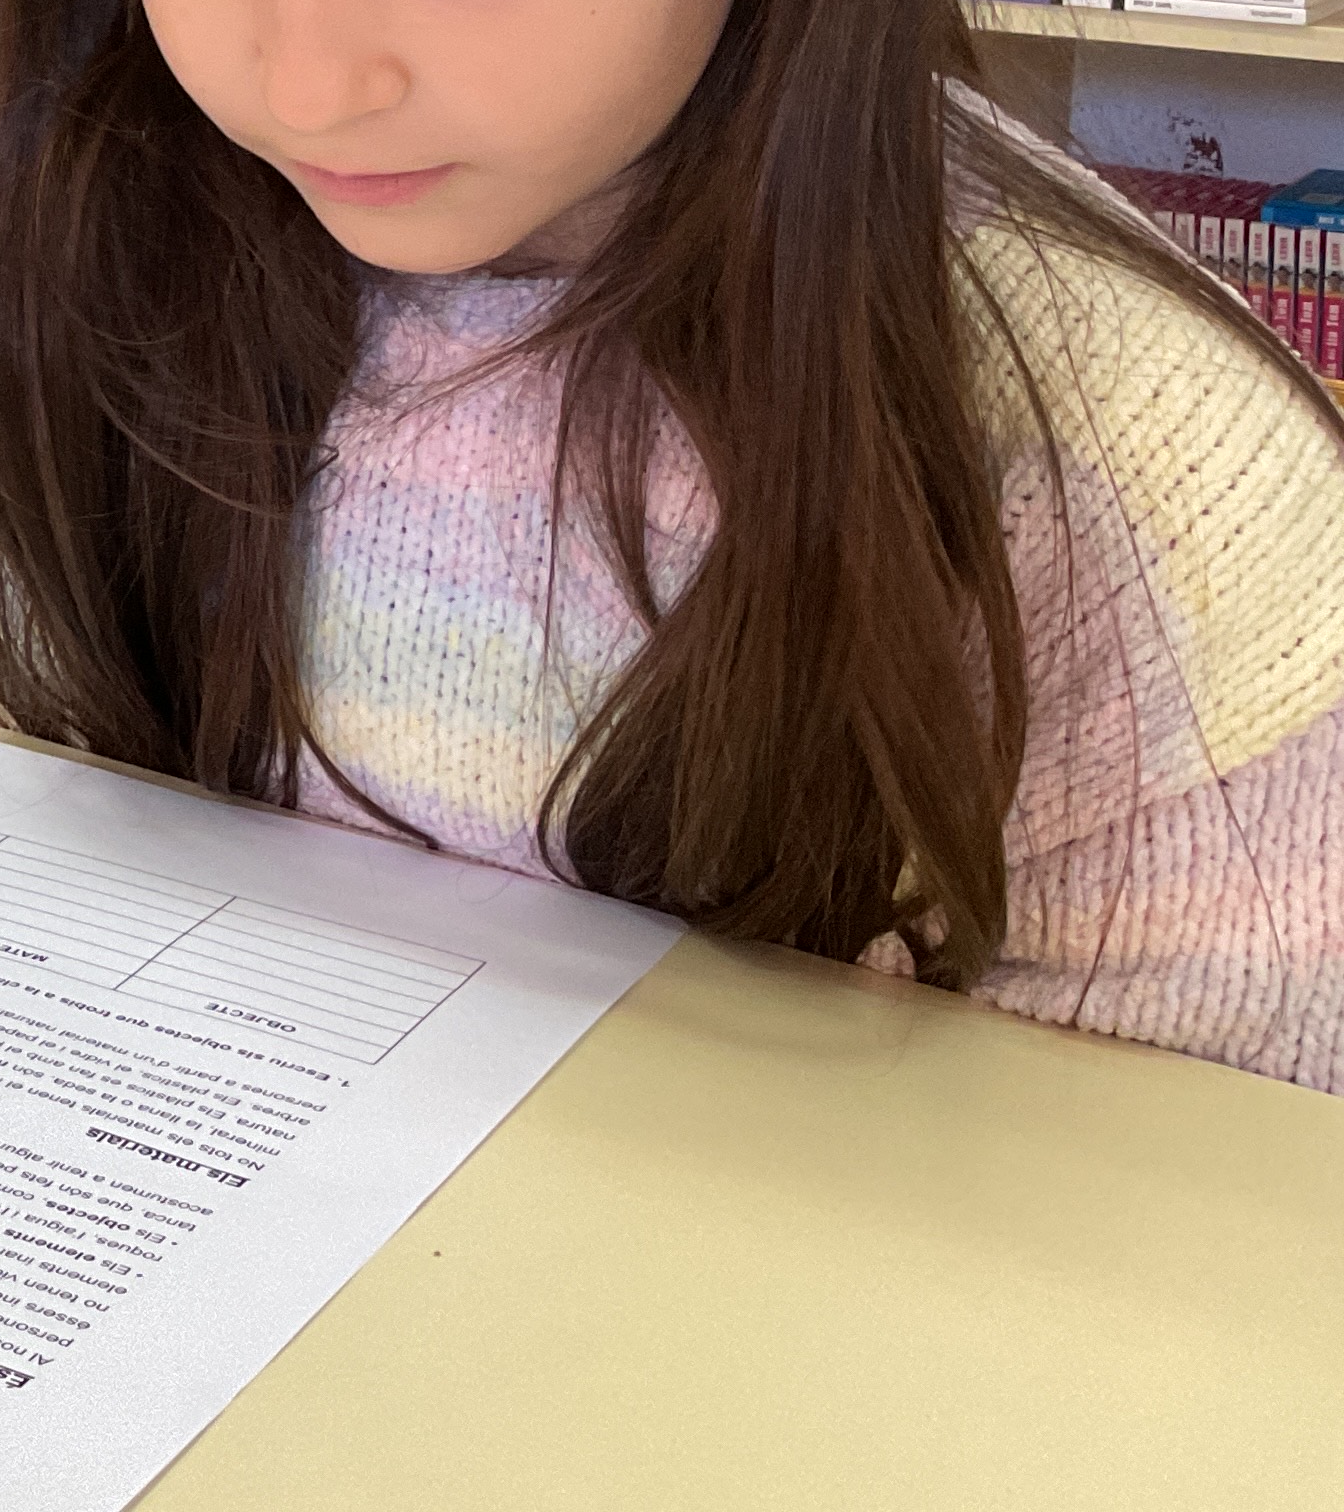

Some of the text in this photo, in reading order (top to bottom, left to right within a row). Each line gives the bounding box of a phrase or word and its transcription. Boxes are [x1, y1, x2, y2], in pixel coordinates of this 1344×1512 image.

[23, 985, 40, 995] la
[59, 997, 111, 1017] trobis
[114, 1015, 149, 1027] que
[203, 1002, 296, 1032] OBJECTE
[153, 1025, 232, 1050] objectes
[236, 1048, 265, 1060] sis
[268, 1057, 331, 1081] Escriu
[84, 1126, 251, 1187] Els materials
[45, 1160, 88, 1178] tenir
[19, 1171, 54, 1187] fets
[57, 1183, 93, 1199] són
[109, 1180, 213, 1215] acostumen
[96, 1197, 133, 1211] que
[23, 1213, 86, 1239] l'aigua
[134, 1228, 166, 1243] Els
[2, 1228, 96, 1261] elements
[100, 1259, 132, 1275] Els
[37, 1261, 127, 1294] elements
[22, 1278, 79, 1303] tenen
[83, 1299, 110, 1312] no
[24, 1302, 91, 1330] éssers
[27, 1352, 55, 1365] Al
